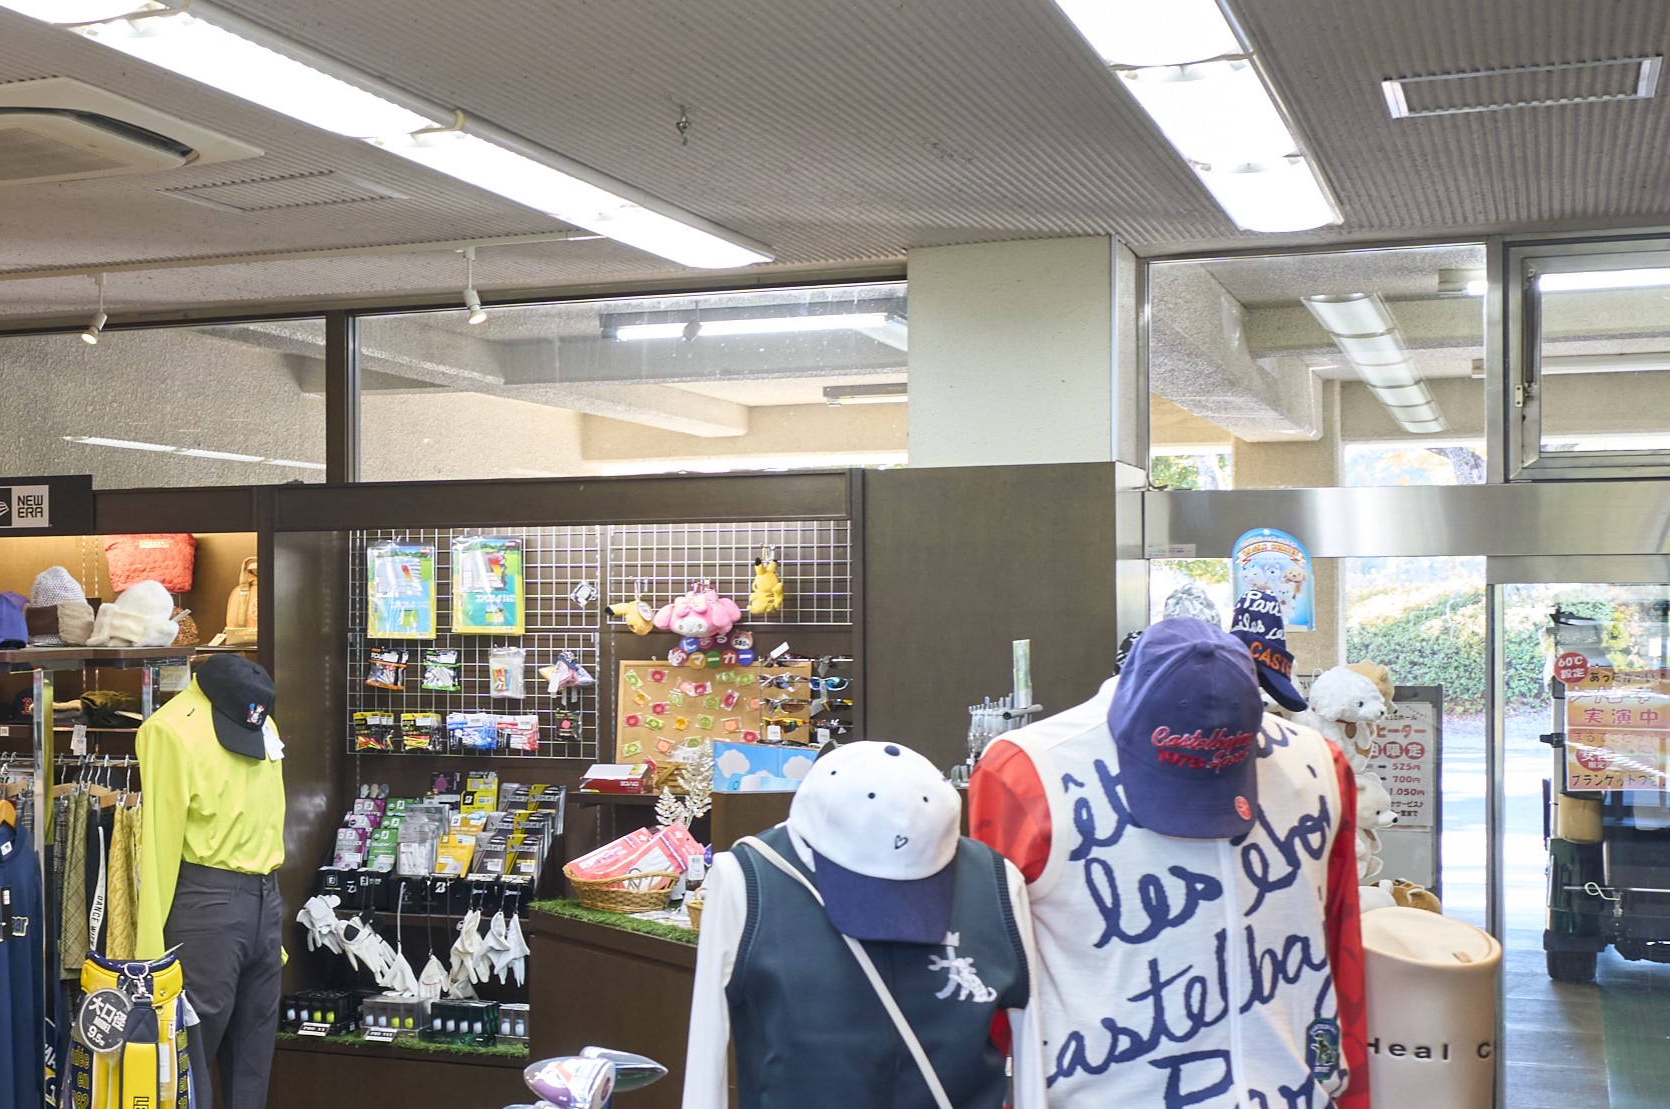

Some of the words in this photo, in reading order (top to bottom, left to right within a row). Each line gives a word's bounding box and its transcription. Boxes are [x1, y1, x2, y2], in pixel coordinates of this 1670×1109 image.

[17, 495, 43, 506] NEW
[17, 507, 43, 518] ERA
[1584, 708, 1659, 725] 実演中
[89, 997, 128, 1031] 大口径
